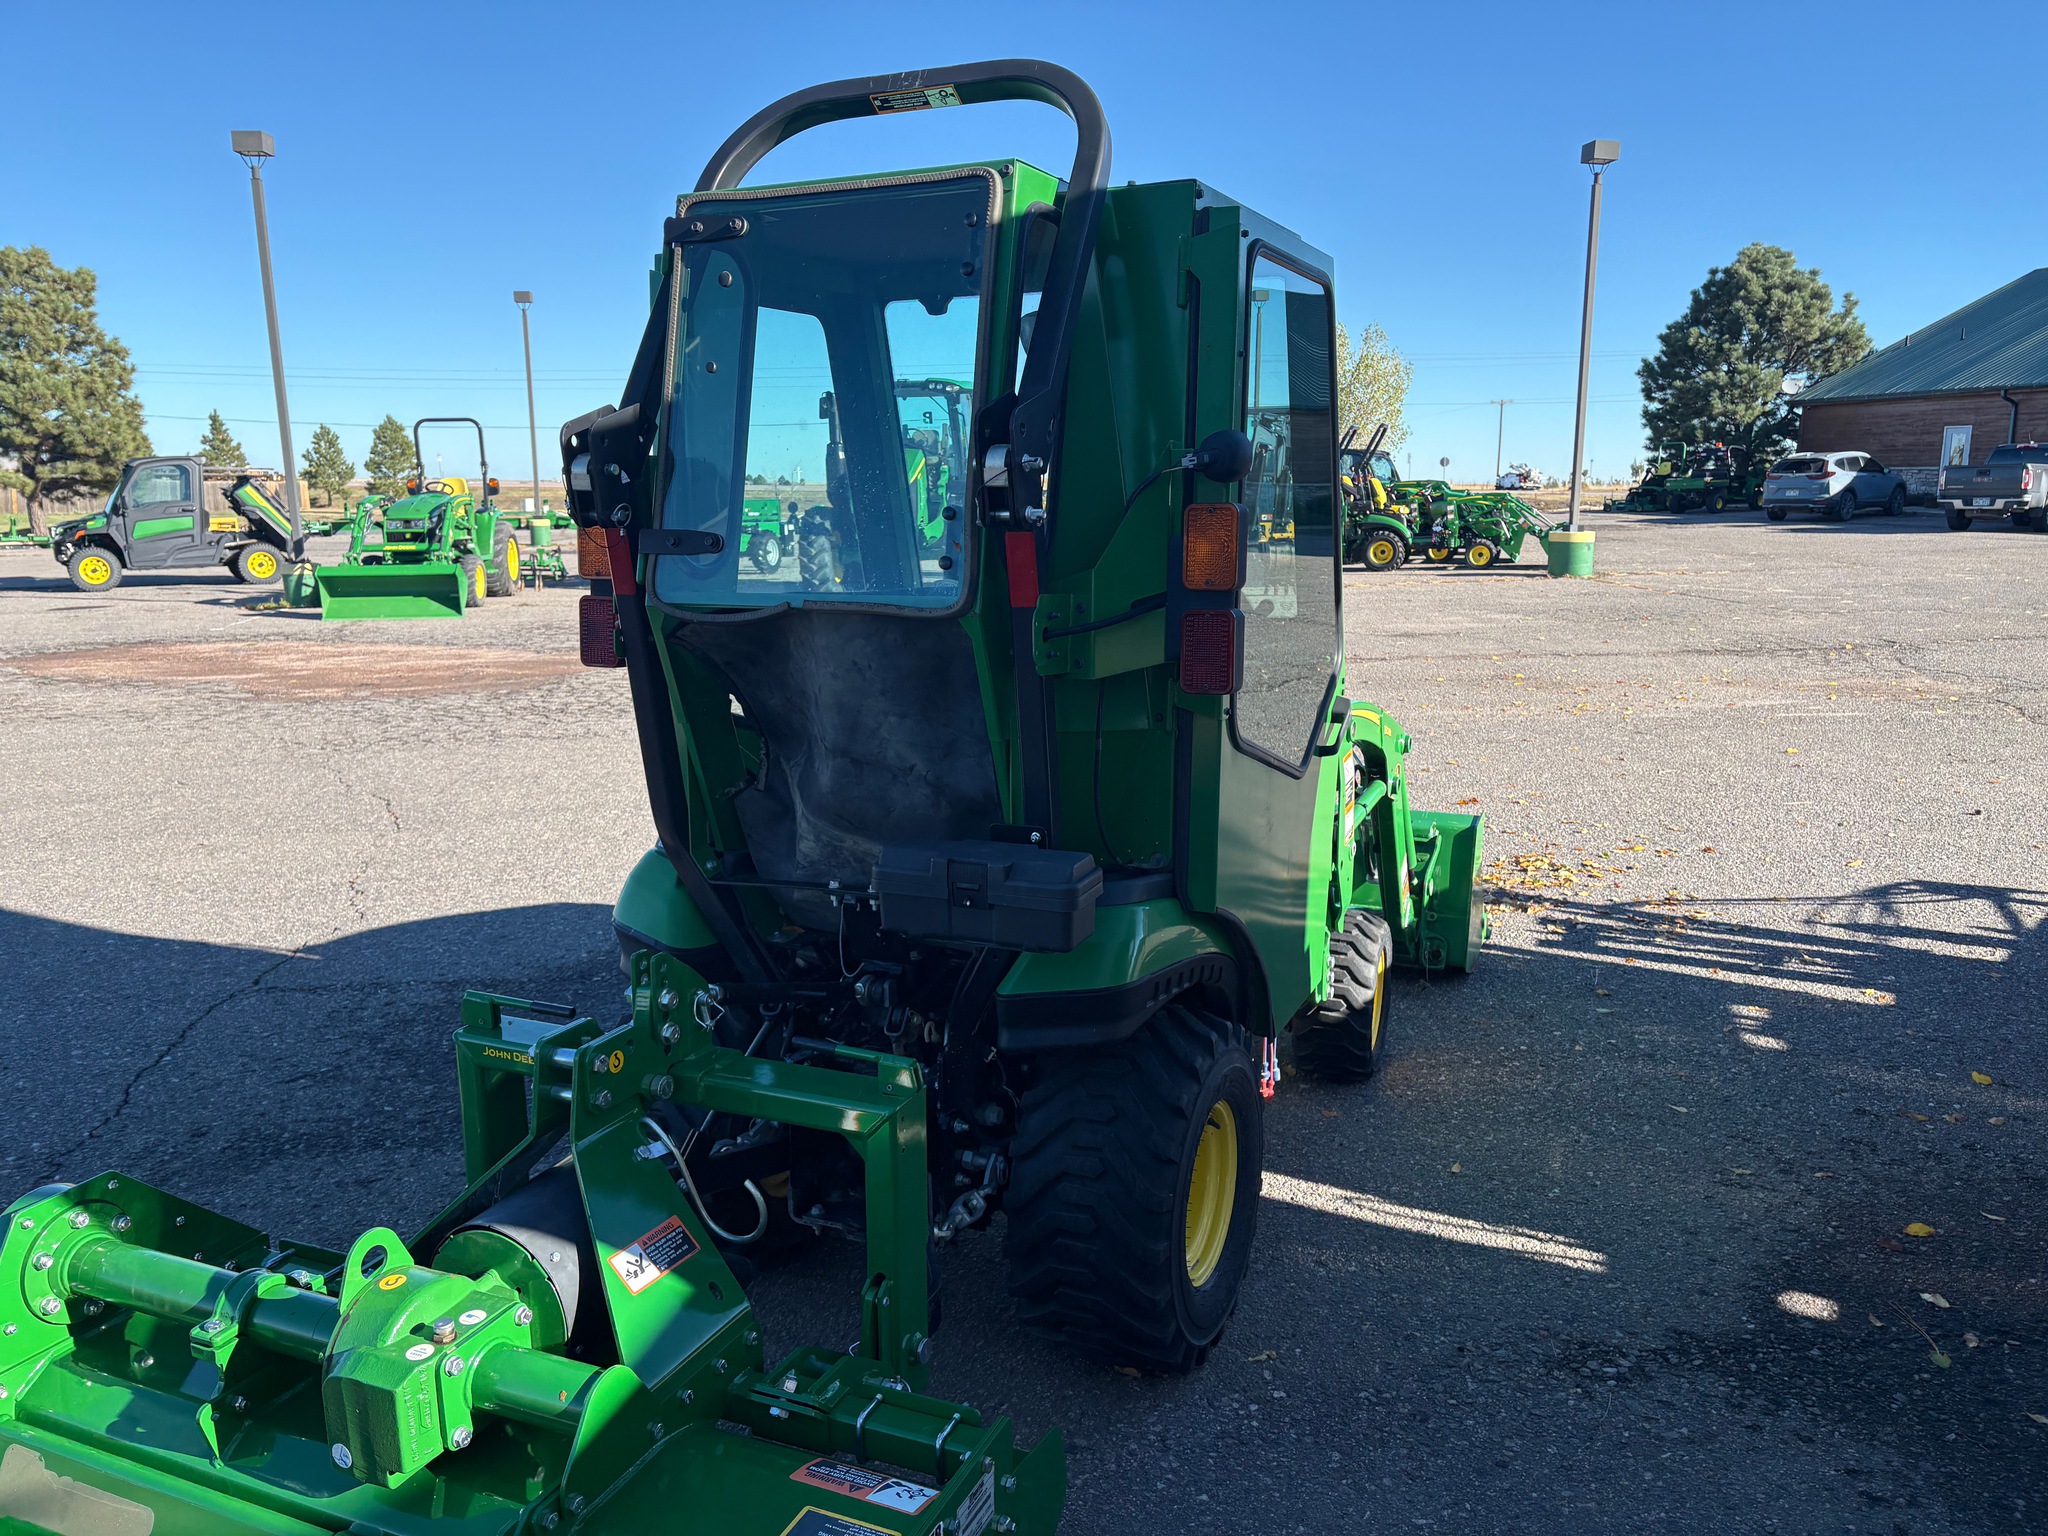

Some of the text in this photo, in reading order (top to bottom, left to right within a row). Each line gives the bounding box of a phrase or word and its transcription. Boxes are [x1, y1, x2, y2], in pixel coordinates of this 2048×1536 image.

[483, 1046, 535, 1065] JOHN DEE
[646, 1222, 674, 1242] WARNING
[804, 1471, 846, 1487] WARNING
[809, 1466, 876, 1486] AVOID INJURY FROM
